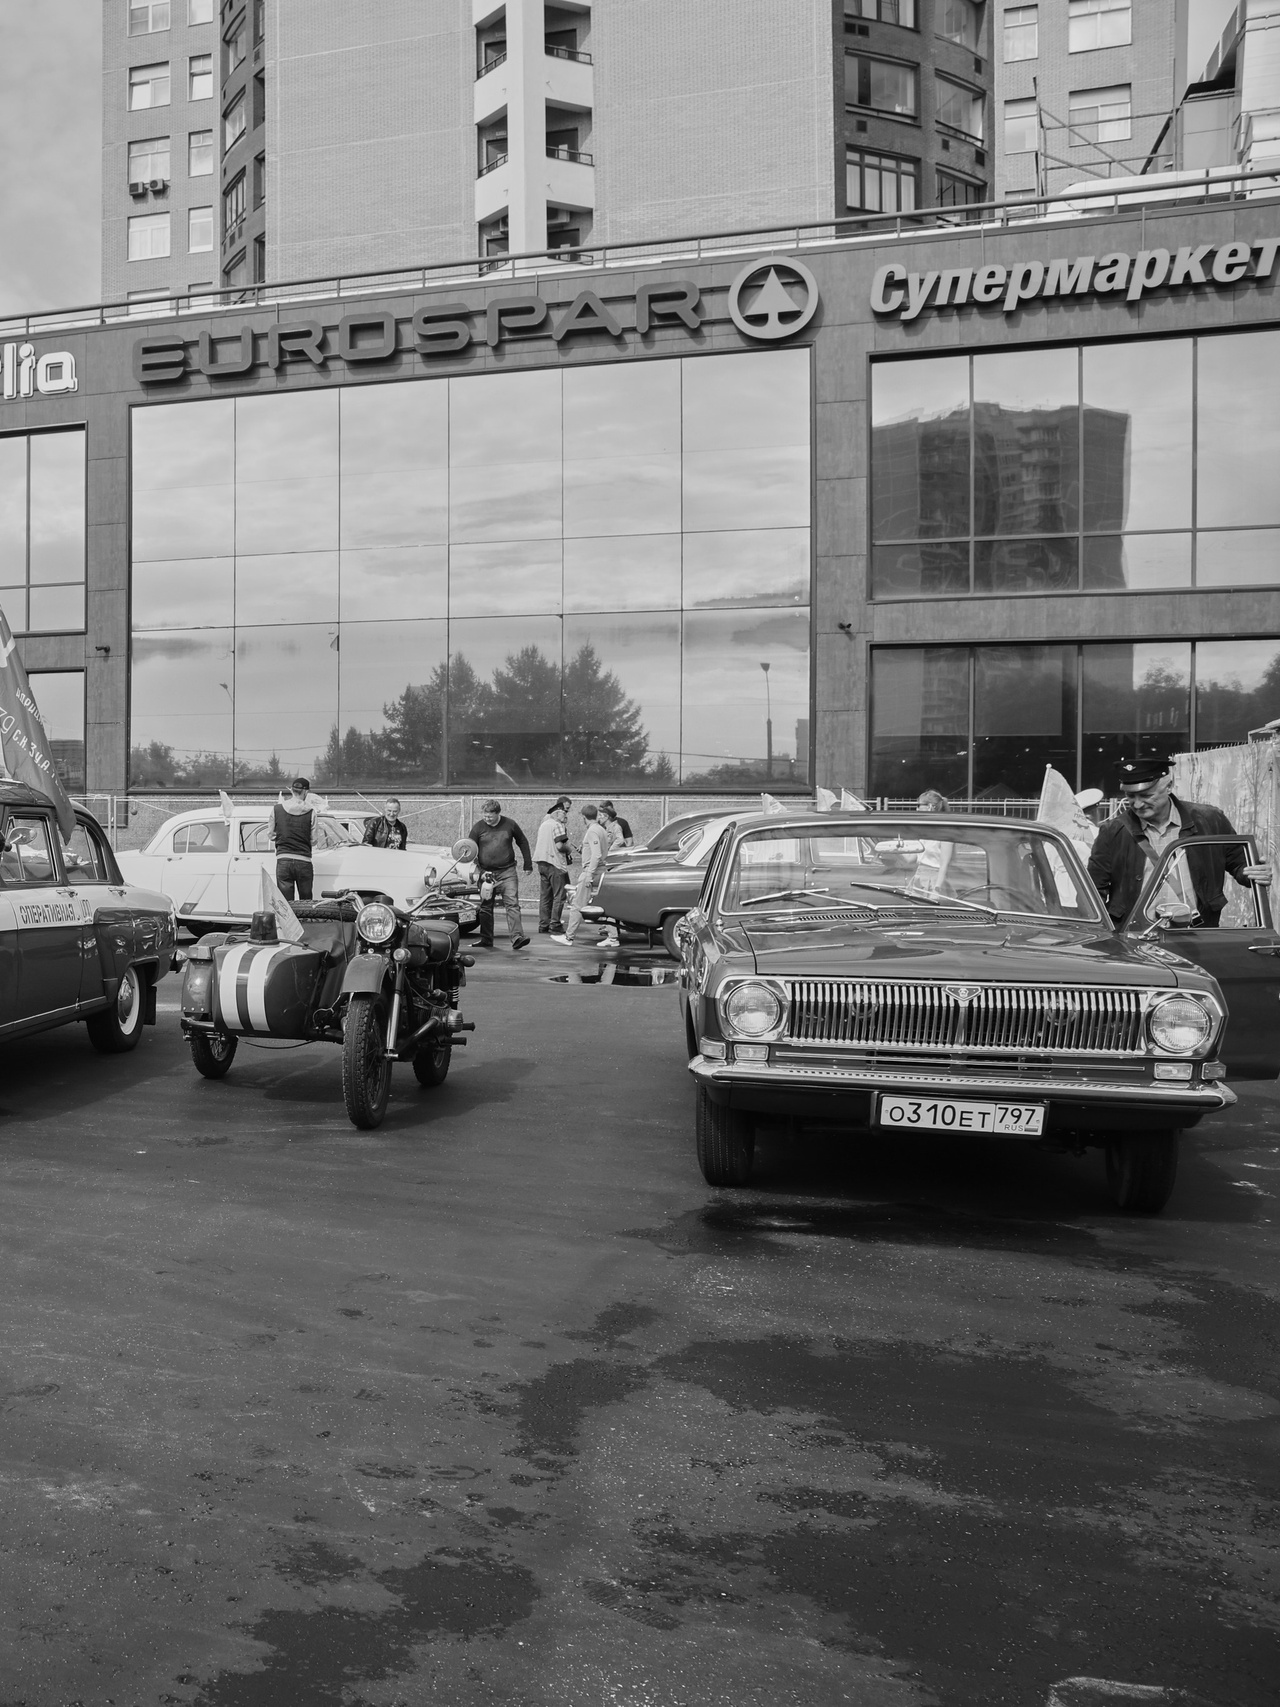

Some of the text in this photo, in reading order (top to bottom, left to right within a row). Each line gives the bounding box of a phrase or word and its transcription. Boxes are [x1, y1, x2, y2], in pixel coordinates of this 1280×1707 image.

[869, 237, 1280, 320] Супермаркет
[132, 280, 702, 383] EUROSPAR
[20, 903, 75, 924] ОПЕРАТИВНАЯ
[889, 1101, 1036, 1129] О310ЕТ 797
[1004, 1124, 1024, 1132] RUS
